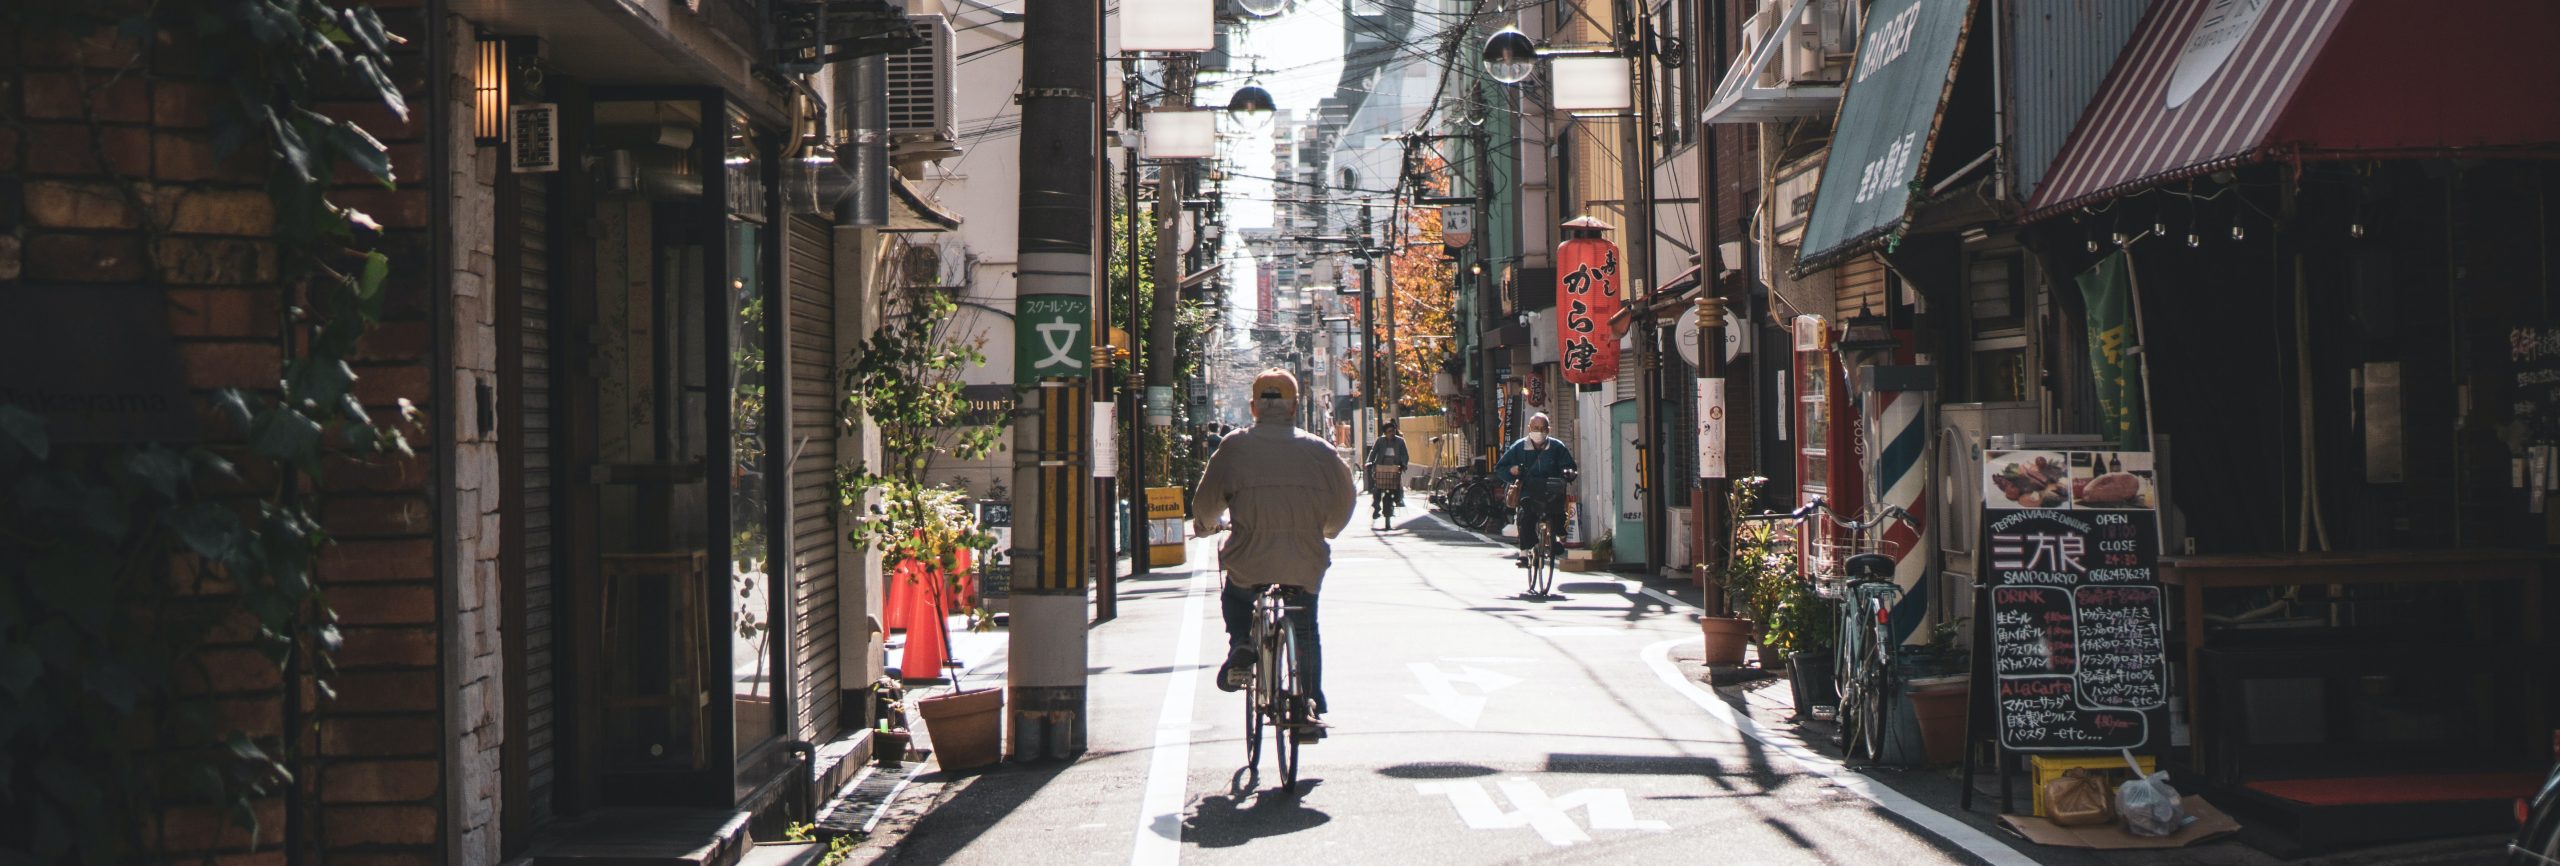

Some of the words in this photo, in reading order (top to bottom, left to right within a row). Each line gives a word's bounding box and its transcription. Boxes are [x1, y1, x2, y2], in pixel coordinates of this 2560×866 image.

[1857, 1, 1921, 83] BARBER
[1600, 249, 1617, 297] 寿し
[1026, 300, 1087, 313] スクール・ゾーン
[1562, 262, 1603, 374] から津
[1034, 315, 1083, 368] 文
[1990, 512, 2028, 533] TEPPAN
[2026, 509, 2059, 520] VIANDE
[2096, 514, 2128, 526] OPEN
[1993, 531, 2087, 572] 三方良
[2099, 540, 2137, 552] CLOSE
[2003, 570, 2078, 585] SANPOURYO
[2089, 567, 2151, 583] 06(6245)6234
[1997, 589, 2046, 605] DRINK
[1997, 609, 2032, 625] 生ビール
[1998, 625, 2046, 642] 角ハイボール
[2003, 694, 2071, 712] マカロニサラダ
[2006, 710, 2078, 728] 自家製ピクルス
[2008, 727, 2047, 742] パスタ
